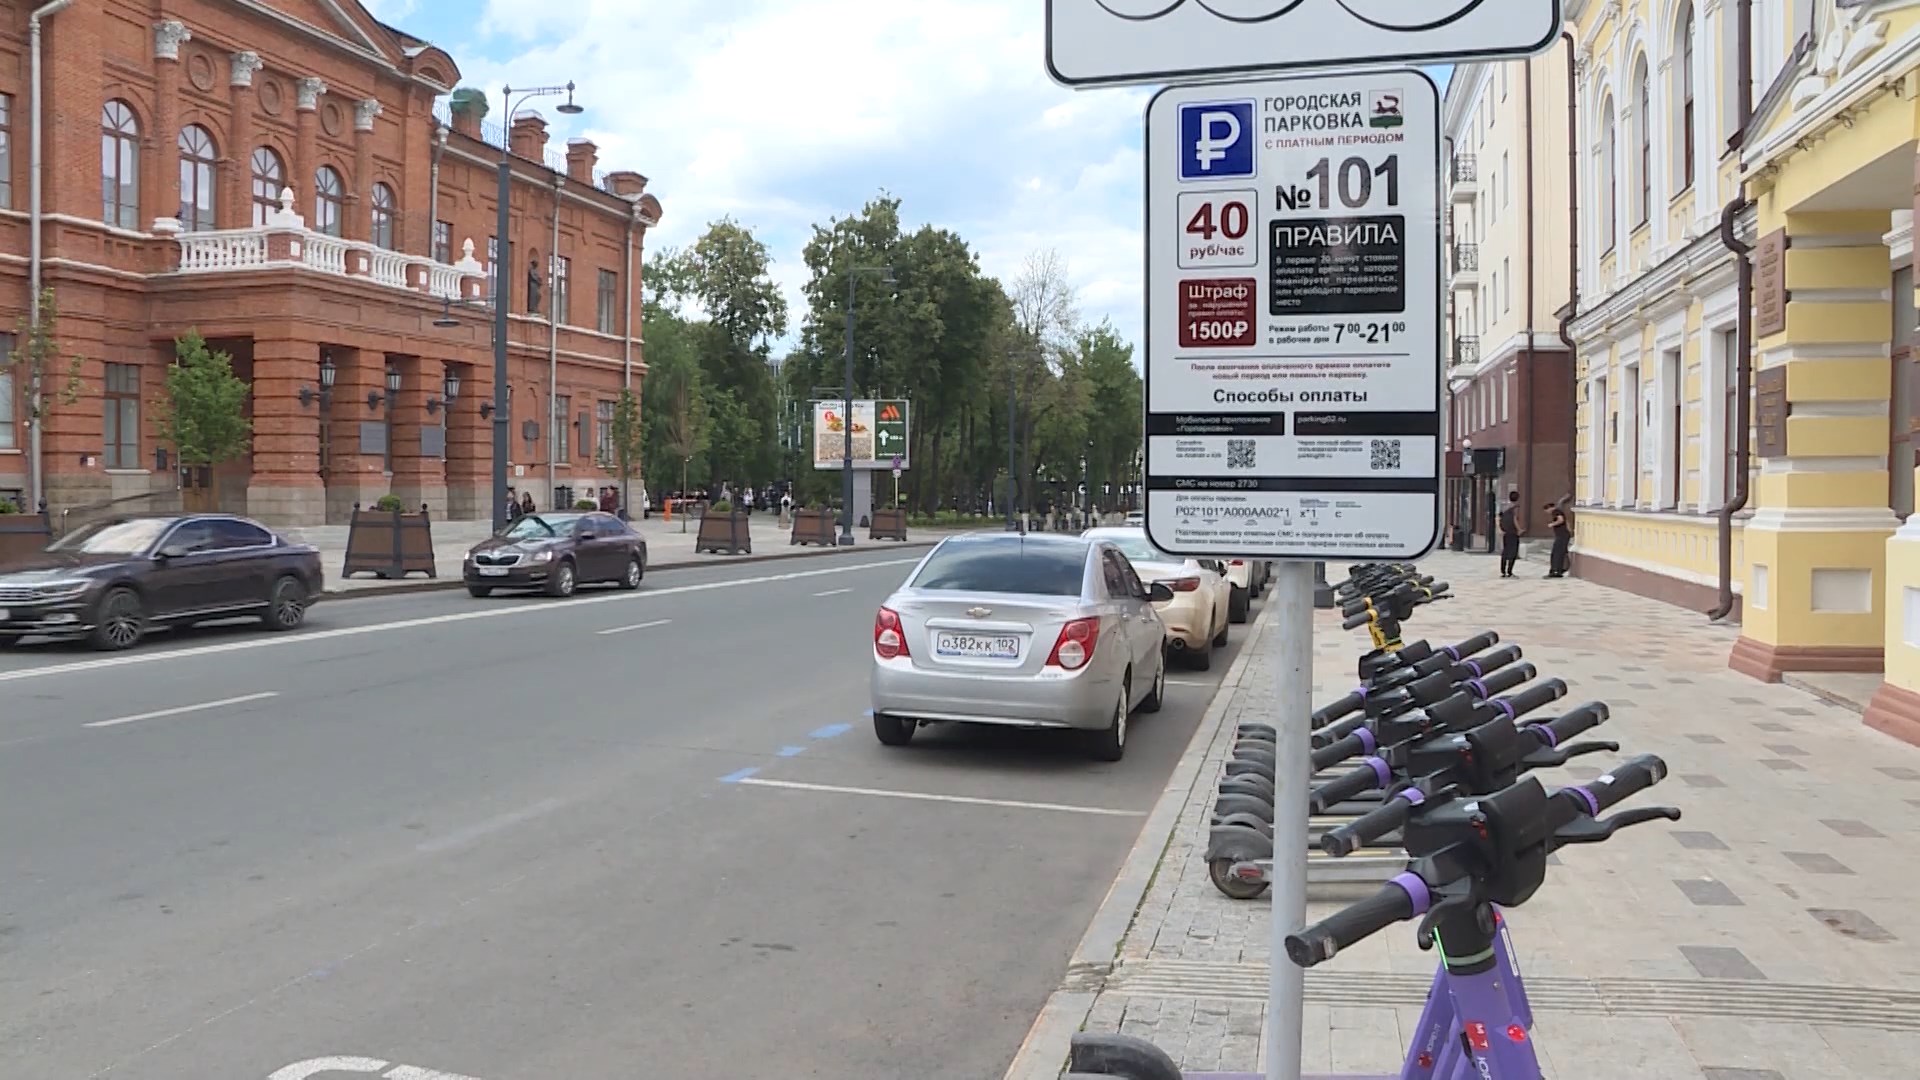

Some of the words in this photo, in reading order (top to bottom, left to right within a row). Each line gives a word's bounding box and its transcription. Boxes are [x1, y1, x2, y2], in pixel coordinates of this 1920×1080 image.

[1265, 92, 1361, 112] ГОРОДСКАЯ
[1265, 112, 1363, 133] ПАРКОВКА
[1265, 139, 1272, 150] С
[1276, 136, 1334, 149] ПЛАТНЫМ
[1338, 133, 1404, 146] ПЕРИОДОМ
[1186, 201, 1249, 241] 40
[1275, 223, 1398, 248] ПРАВИЛА
[1190, 243, 1245, 258] руб/час
[1188, 283, 1248, 301] Штраф
[1298, 324, 1330, 334] работы
[1213, 388, 1294, 404] Способы
[1299, 390, 1368, 403] оплаты
[1176, 480, 1197, 488] СМС
[1237, 480, 1258, 488] 2730
